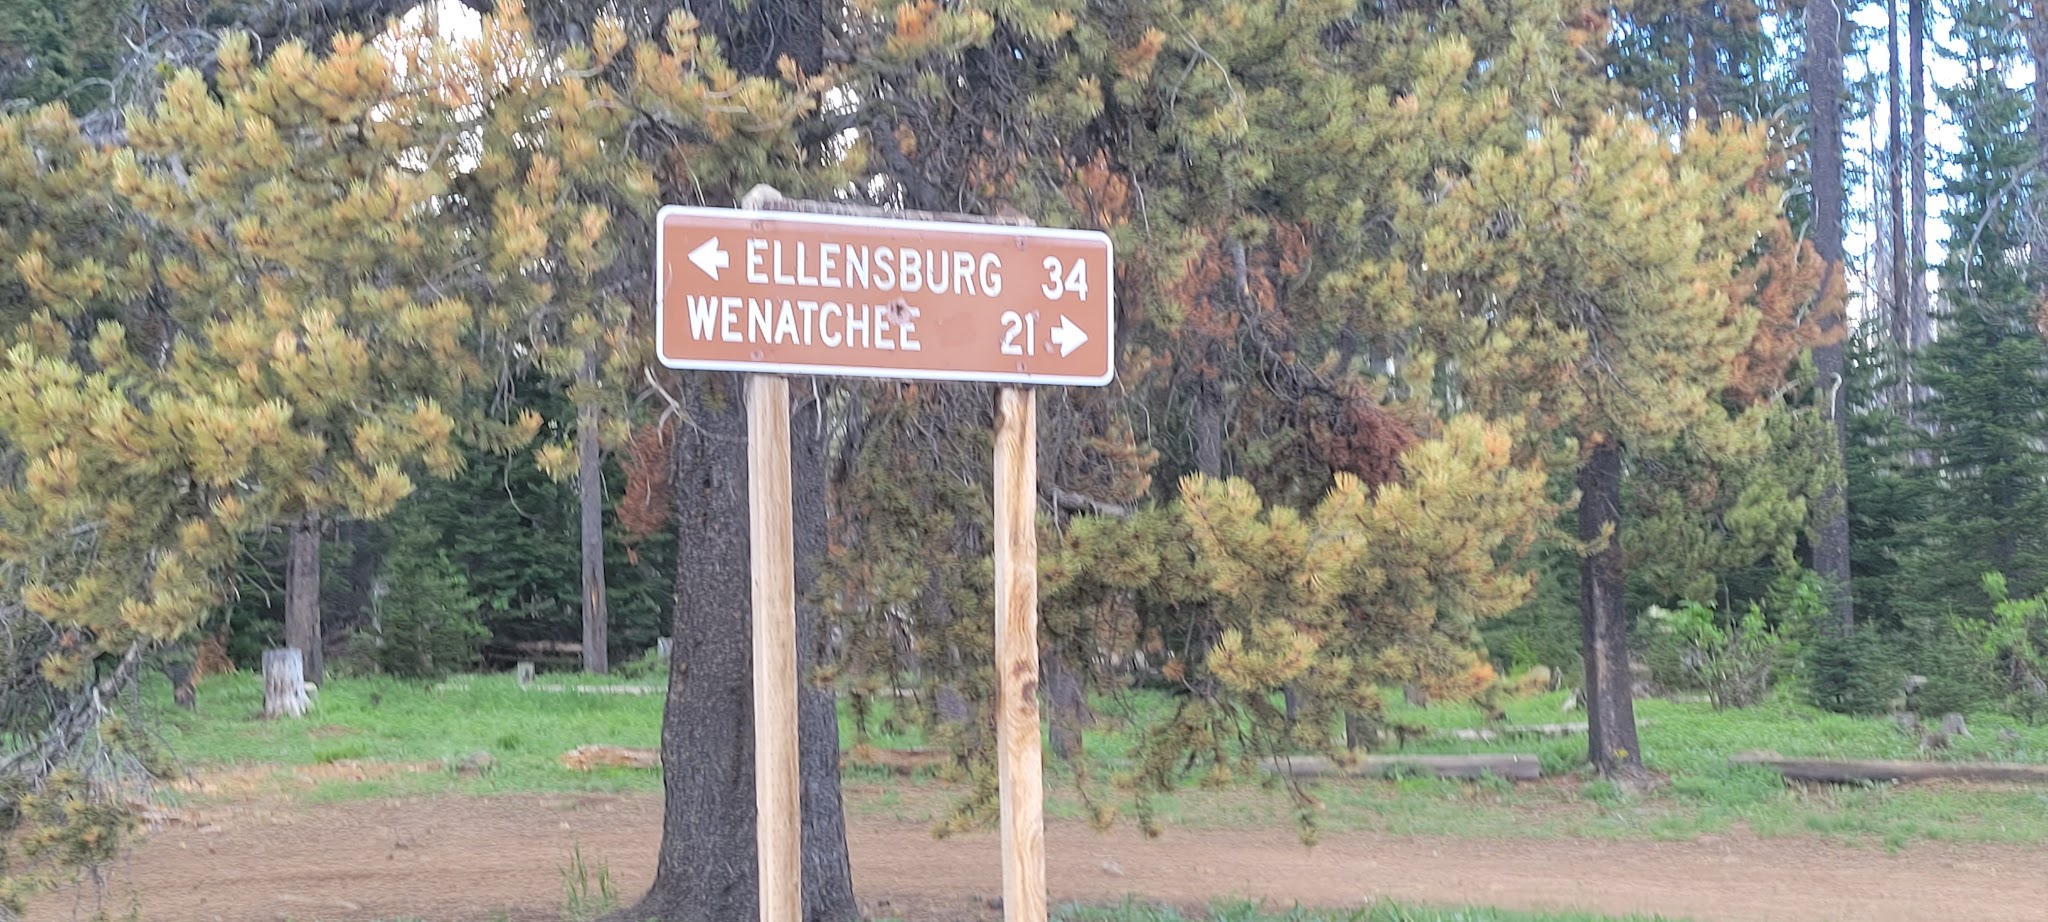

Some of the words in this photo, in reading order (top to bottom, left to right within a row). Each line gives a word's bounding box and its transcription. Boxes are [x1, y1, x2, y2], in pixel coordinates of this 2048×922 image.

[746, 238, 1002, 298] ELLENSBURG
[1041, 255, 1088, 301] 34
[686, 294, 921, 352] WENATCHEE
[1001, 310, 1034, 356] 21
